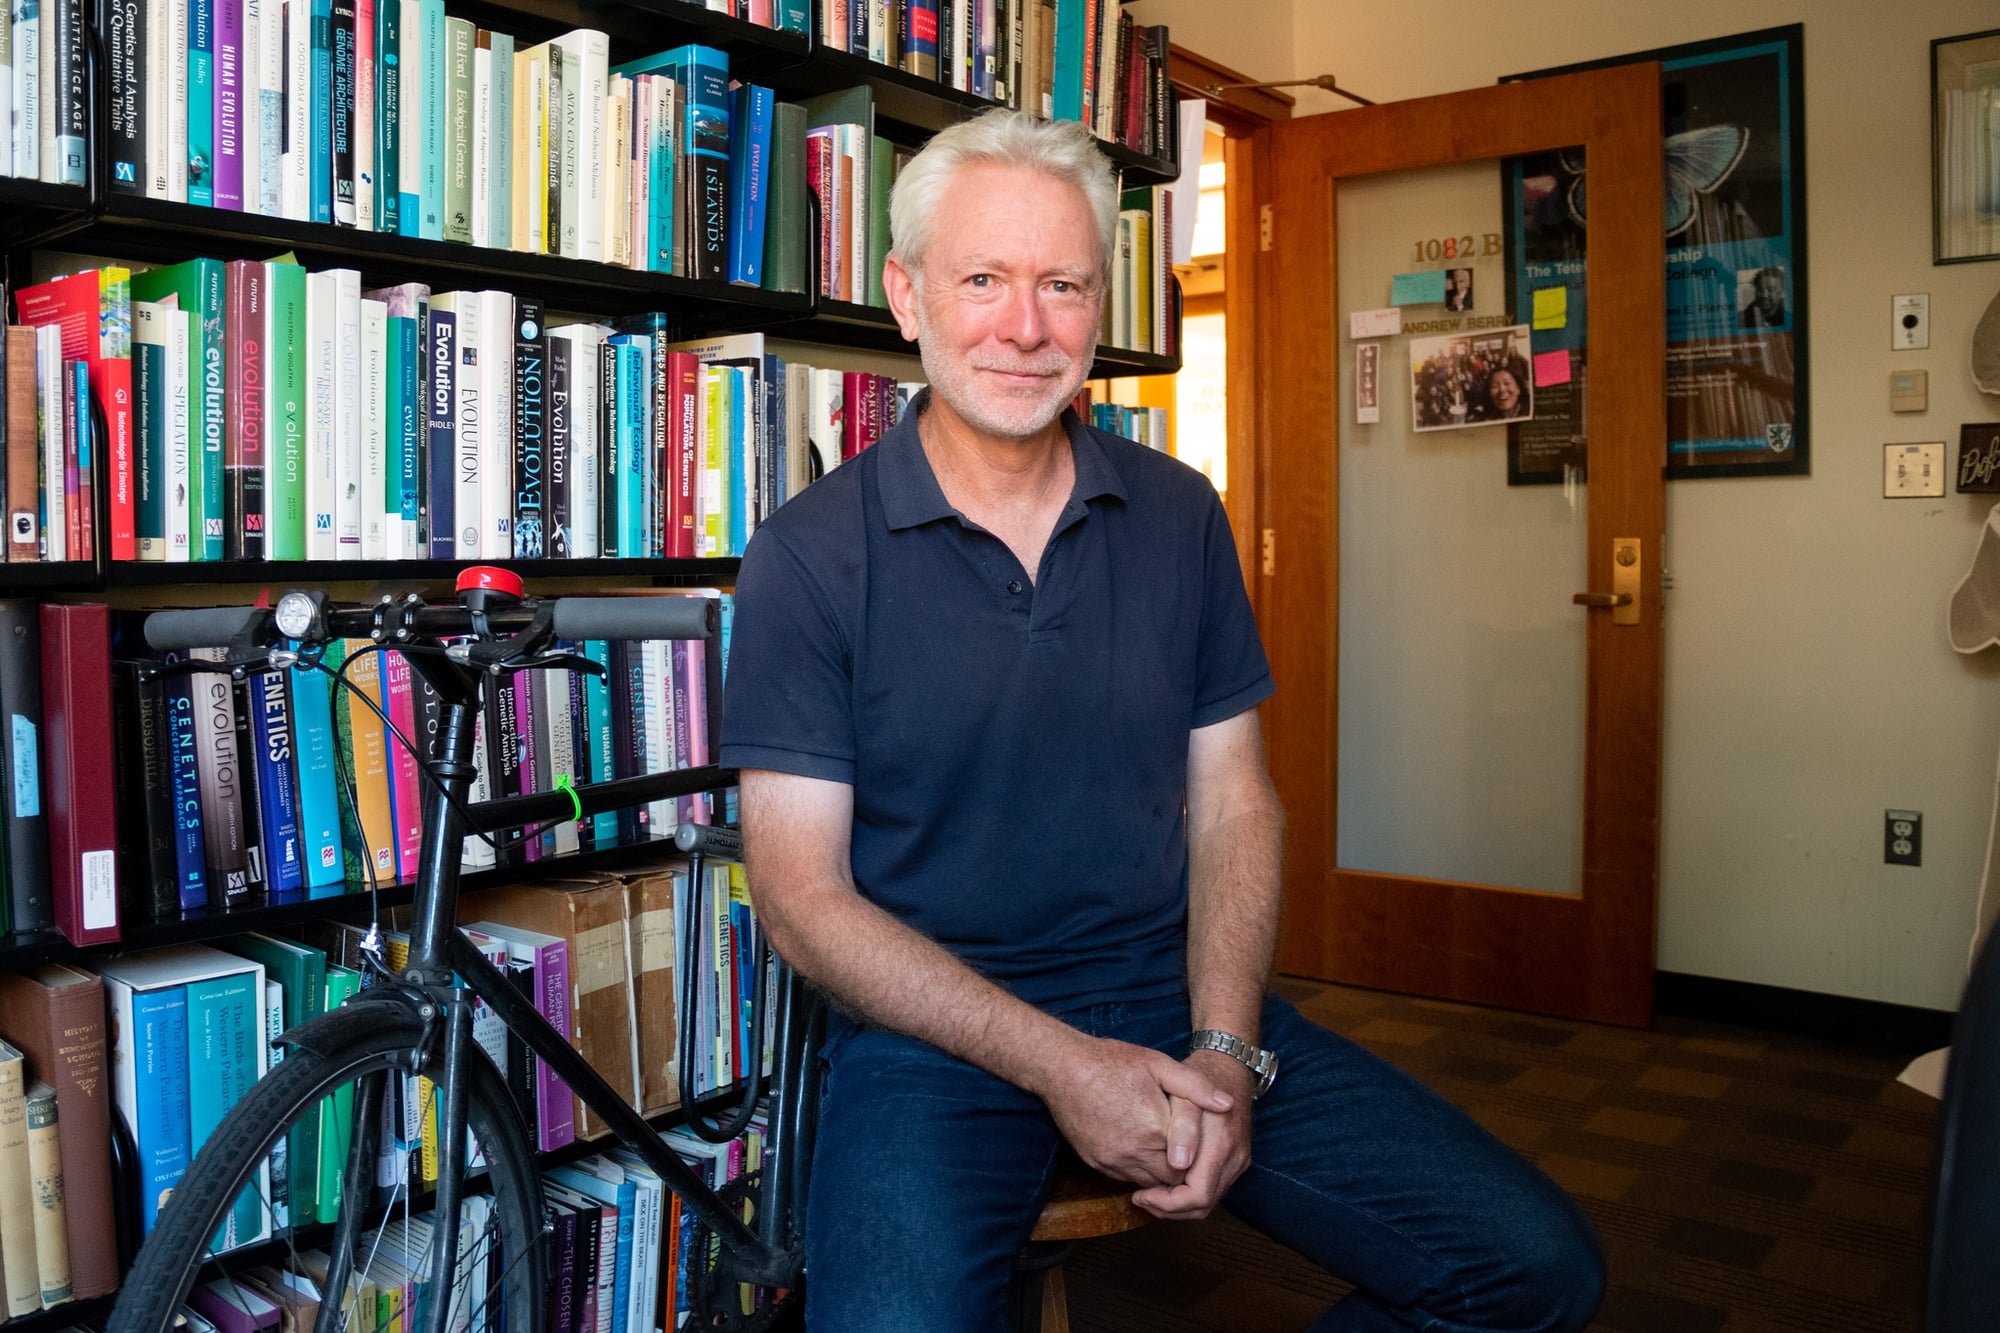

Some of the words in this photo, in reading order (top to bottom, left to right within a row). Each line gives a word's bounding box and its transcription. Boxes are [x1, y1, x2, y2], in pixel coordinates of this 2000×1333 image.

[126, 3, 138, 56] Genetics
[335, 7, 354, 18] LYNCH
[856, 3, 864, 36] WRITING
[25, 28, 36, 64] Fossils
[72, 12, 81, 61] LITTLE
[176, 2, 185, 63] EVOLUTION
[335, 27, 347, 77] GENOME
[346, 31, 354, 51] THE
[110, 15, 124, 94] Quantitative
[126, 58, 138, 83] and
[177, 65, 185, 73] IS
[221, 45, 235, 87] HUMAN
[297, 41, 305, 105] PSYCHOLOGY
[346, 52, 354, 96] ORIGINS
[455, 55, 467, 78] Ford
[551, 50, 559, 74] Grant
[25, 73, 36, 130] Evolution
[72, 70, 81, 94] ICE
[177, 75, 185, 104] TRUE
[73, 101, 82, 130] AGE
[112, 97, 123, 131] Traits
[124, 84, 138, 140] Analysis
[221, 90, 235, 156] EVOLUTION
[335, 78, 347, 154] ARCHITECTURE
[346, 97, 354, 112] OF
[453, 89, 468, 143] Ecological
[549, 76, 559, 131] Evolution
[566, 88, 575, 126] AVIAN
[592, 93, 600, 114] Birds
[592, 114, 600, 123] of
[297, 105, 305, 177] EVOLUTIONARY
[566, 129, 575, 188] GENETICS
[591, 124, 600, 161] Northern
[455, 142, 467, 189] Genetics
[549, 150, 559, 188] Islands
[591, 161, 600, 199] Melanesia
[749, 142, 761, 203] EVOLUTION
[705, 166, 719, 253] ISLANDS
[1414, 236, 1475, 263] 1082
[1481, 232, 1503, 257] B
[1526, 265, 1551, 279] The
[210, 272, 218, 312] FUTUYMA
[249, 277, 258, 313] FUTUYMA
[176, 329, 185, 358] COYNE
[1401, 317, 1461, 336] ANDREW
[1467, 314, 1514, 330] BERRY
[342, 322, 358, 409] Evolution
[435, 322, 452, 415] Evolution
[609, 347, 617, 355] An
[657, 330, 667, 369] SPECIES
[177, 360, 185, 379] ORR
[323, 339, 331, 426] EVOLUTIONARY
[368, 349, 379, 423] Evolutionary
[608, 355, 617, 400] Introduction
[631, 350, 641, 423] Behavioural
[657, 371, 667, 392] AND
[53, 376, 63, 449] ELEPHANTS
[205, 347, 224, 452] evolution
[243, 339, 265, 452] evolution
[316, 375, 324, 426] BIOLOGY
[417, 379, 428, 414] Biological
[609, 400, 617, 409] to
[868, 379, 877, 440] DARWIN
[116, 411, 127, 461] Biotechnologie
[174, 385, 186, 476] SPECIATION
[418, 413, 428, 447] Evolution
[429, 420, 455, 429] RIDLEY
[461, 388, 478, 484] EVOLUTION
[517, 356, 541, 510] EVOLUTION
[552, 390, 568, 483] Evolution
[585, 385, 595, 451] Evolutionary
[608, 409, 617, 449] Behavioural
[657, 393, 667, 449] SPECIATION
[754, 414, 761, 422] of
[284, 401, 301, 483] evolution
[369, 428, 379, 476] Analysis
[403, 405, 416, 479] evolution
[630, 426, 641, 476] Ecology
[688, 449, 695, 462] OF
[767, 424, 775, 474] Evolutionary
[54, 450, 63, 482] HATE
[117, 461, 127, 471] für
[586, 452, 595, 493] Analysis
[608, 448, 617, 476] Ecology
[54, 485, 63, 516] BEES
[116, 471, 128, 504] Einsteiger
[352, 656, 378, 673] LIFE
[354, 673, 379, 684] WORKS
[389, 667, 412, 683] LIFE
[391, 683, 412, 694] WORKS
[663, 675, 671, 705] What
[675, 688, 687, 720] GENETIC
[263, 670, 290, 762] ENETICS
[497, 688, 509, 732] Genetic
[506, 687, 518, 755] Introduction
[632, 667, 646, 758] GENETICS
[664, 705, 671, 717] Is
[140, 699, 157, 791] DROSOPHILA
[170, 709, 181, 774] CONCEPTUAL
[211, 682, 237, 800] evolution
[563, 703, 573, 765] MOLECULAR
[664, 717, 672, 743] Life?
[676, 721, 688, 757] ANALYSIS
[176, 696, 199, 829] GENETICS
[500, 732, 513, 777] Analysis
[509, 755, 519, 768] to
[174, 777, 186, 831] APPROACH
[227, 801, 236, 826] FOURTH
[229, 826, 238, 851] EDITION
[719, 914, 729, 968] GENETICS
[546, 974, 556, 1013] HUMAN
[146, 1022, 154, 1040] Snow
[232, 1003, 244, 1027] The
[147, 1042, 154, 1050] &
[147, 1050, 155, 1074] Perrins
[157, 1020, 170, 1072] Western
[234, 1030, 246, 1064] Birds
[235, 1068, 246, 1081] of
[160, 1076, 175, 1139] Palearctic
[640, 1199, 648, 1215] SEX
[640, 1217, 646, 1229] ON
[565, 1219, 573, 1241] KUPER
[562, 1245, 574, 1275] THE
[598, 1216, 617, 1285] DESMOND
[637, 1246, 645, 1268] BRAIN
[560, 1277, 573, 1329] CHOSEN
